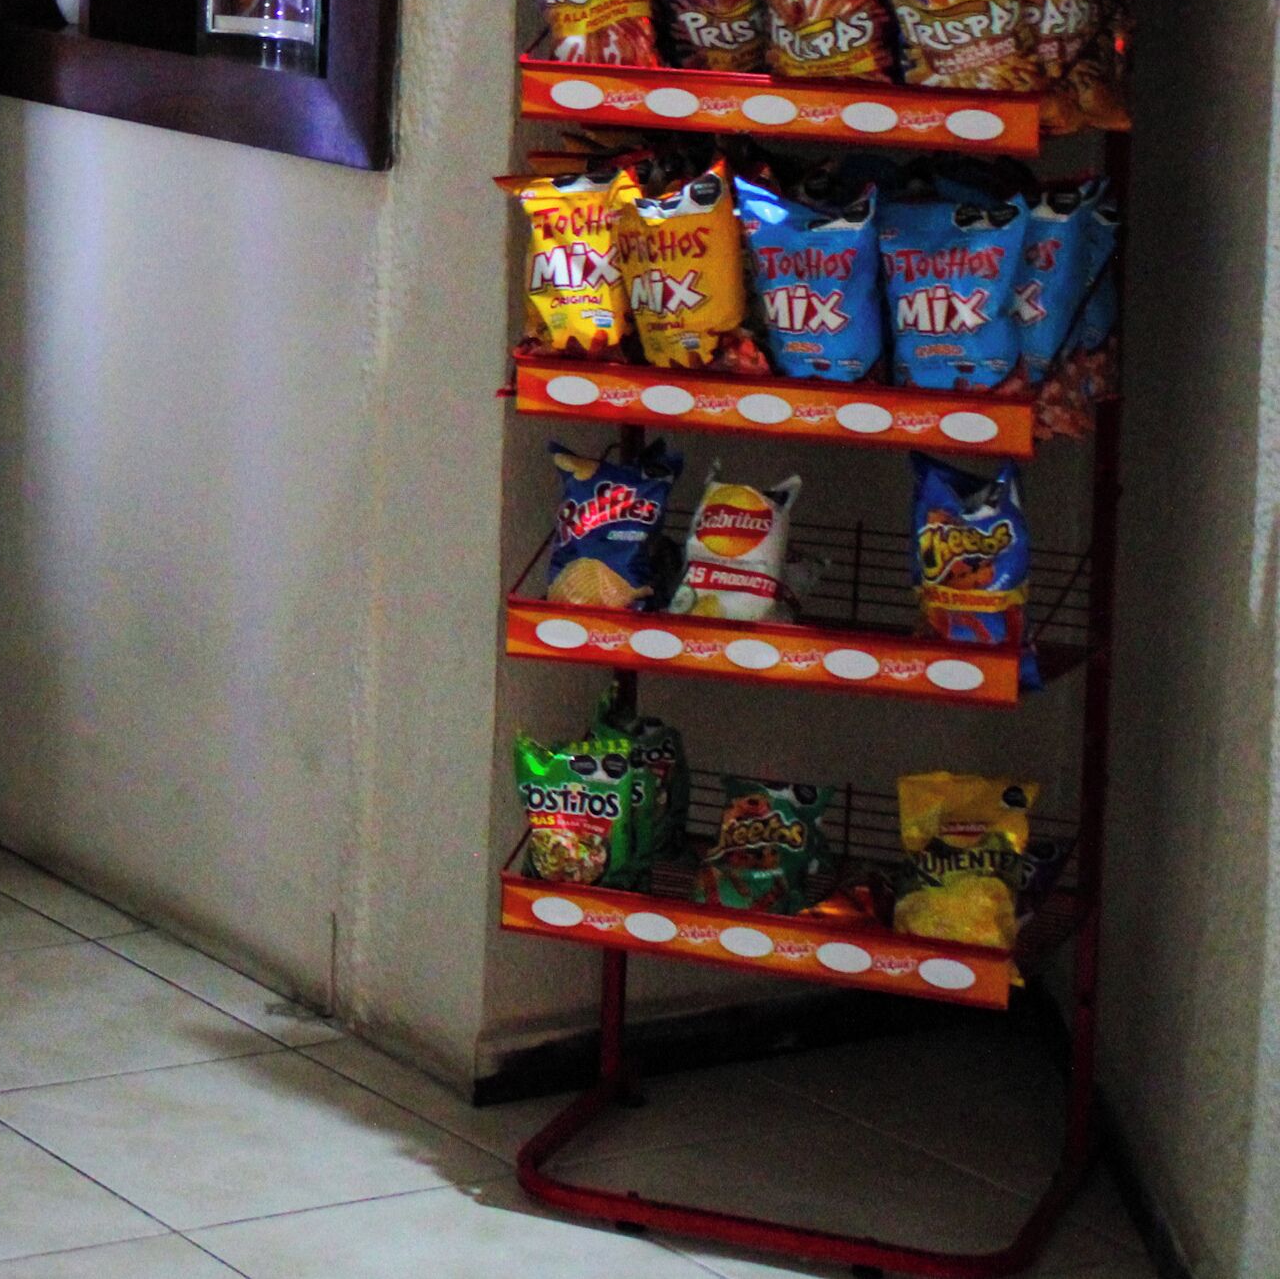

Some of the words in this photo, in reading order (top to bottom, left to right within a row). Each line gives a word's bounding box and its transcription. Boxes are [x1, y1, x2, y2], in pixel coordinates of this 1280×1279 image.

[678, 10, 756, 50] PRIS
[556, 481, 659, 547] Ruffles
[697, 507, 772, 532] Sabritas
